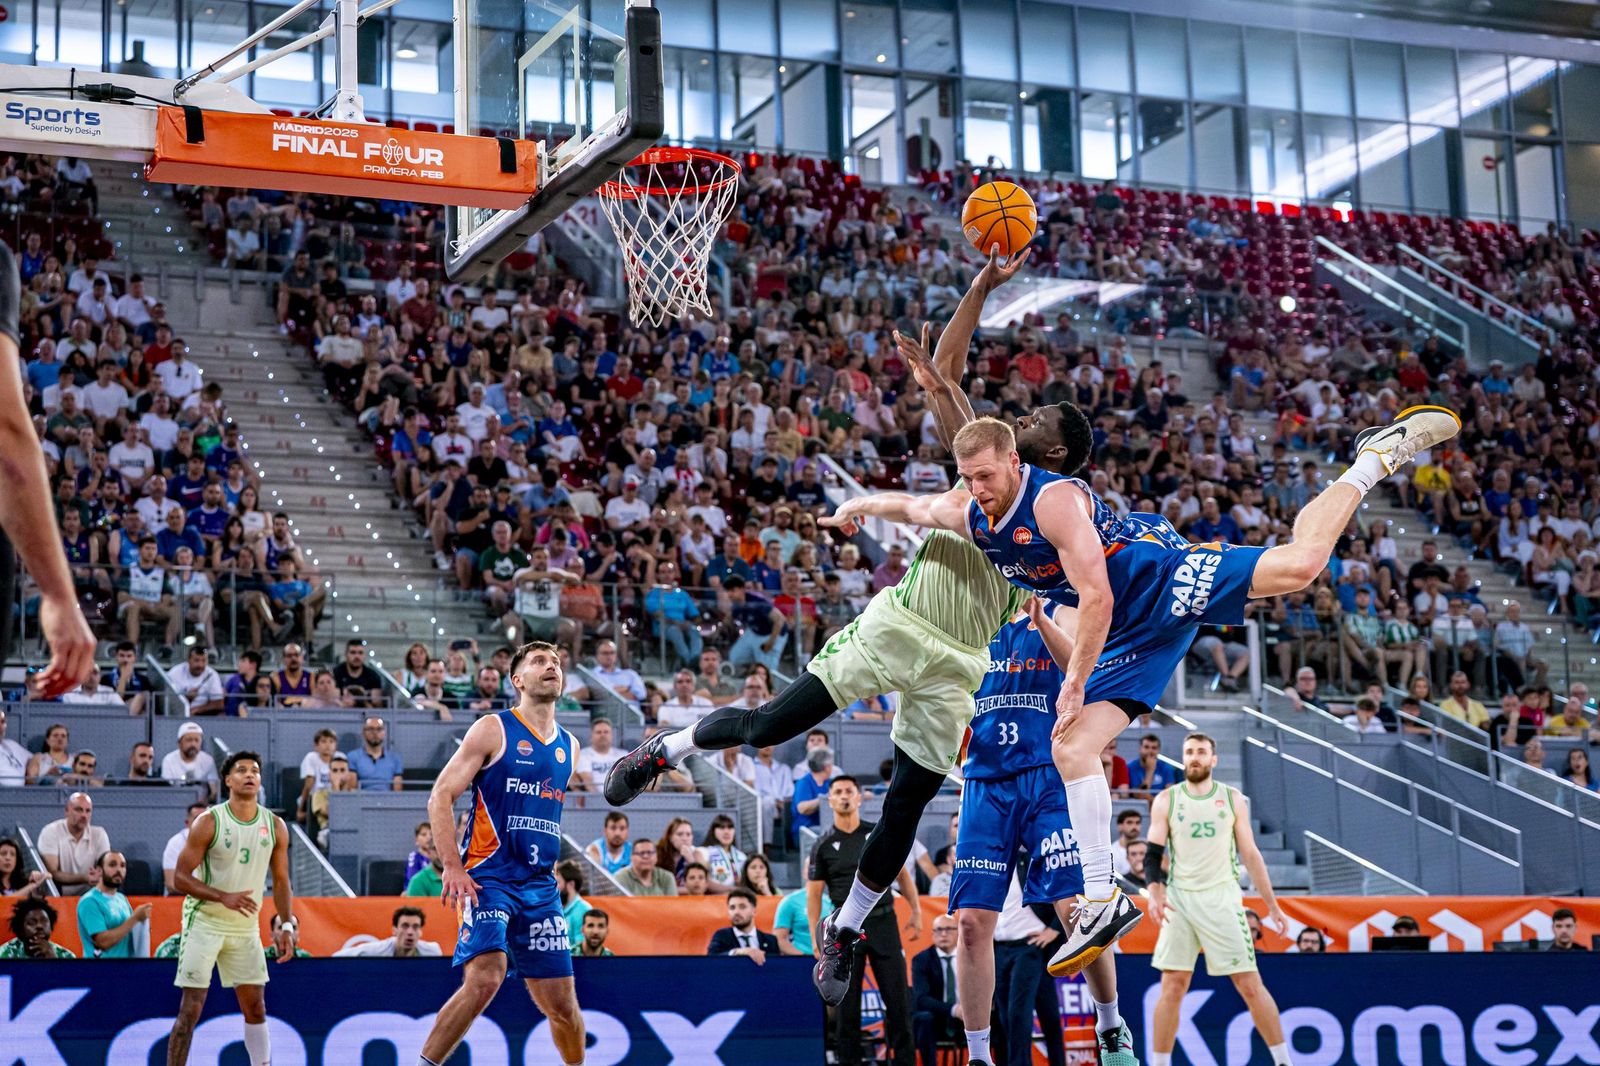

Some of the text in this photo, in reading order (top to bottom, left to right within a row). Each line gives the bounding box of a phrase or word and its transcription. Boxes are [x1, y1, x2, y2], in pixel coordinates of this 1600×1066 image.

[5, 102, 101, 125] Sports
[31, 123, 102, 137] Superior by Design
[272, 121, 359, 138] MADRID2025
[272, 133, 444, 167] FINAL FOUR
[363, 164, 444, 180] PRIMERA FEB
[1171, 553, 1222, 617] PAPA JOHNS
[975, 693, 1049, 717] FUENLABRADA
[997, 721, 1020, 746] 33
[1190, 821, 1217, 838] 25
[1041, 828, 1081, 856] PAP
[239, 847, 251, 865] 3
[528, 843, 540, 866] 3
[954, 855, 1008, 872] invictum
[1142, 981, 1600, 1066] Kromex
